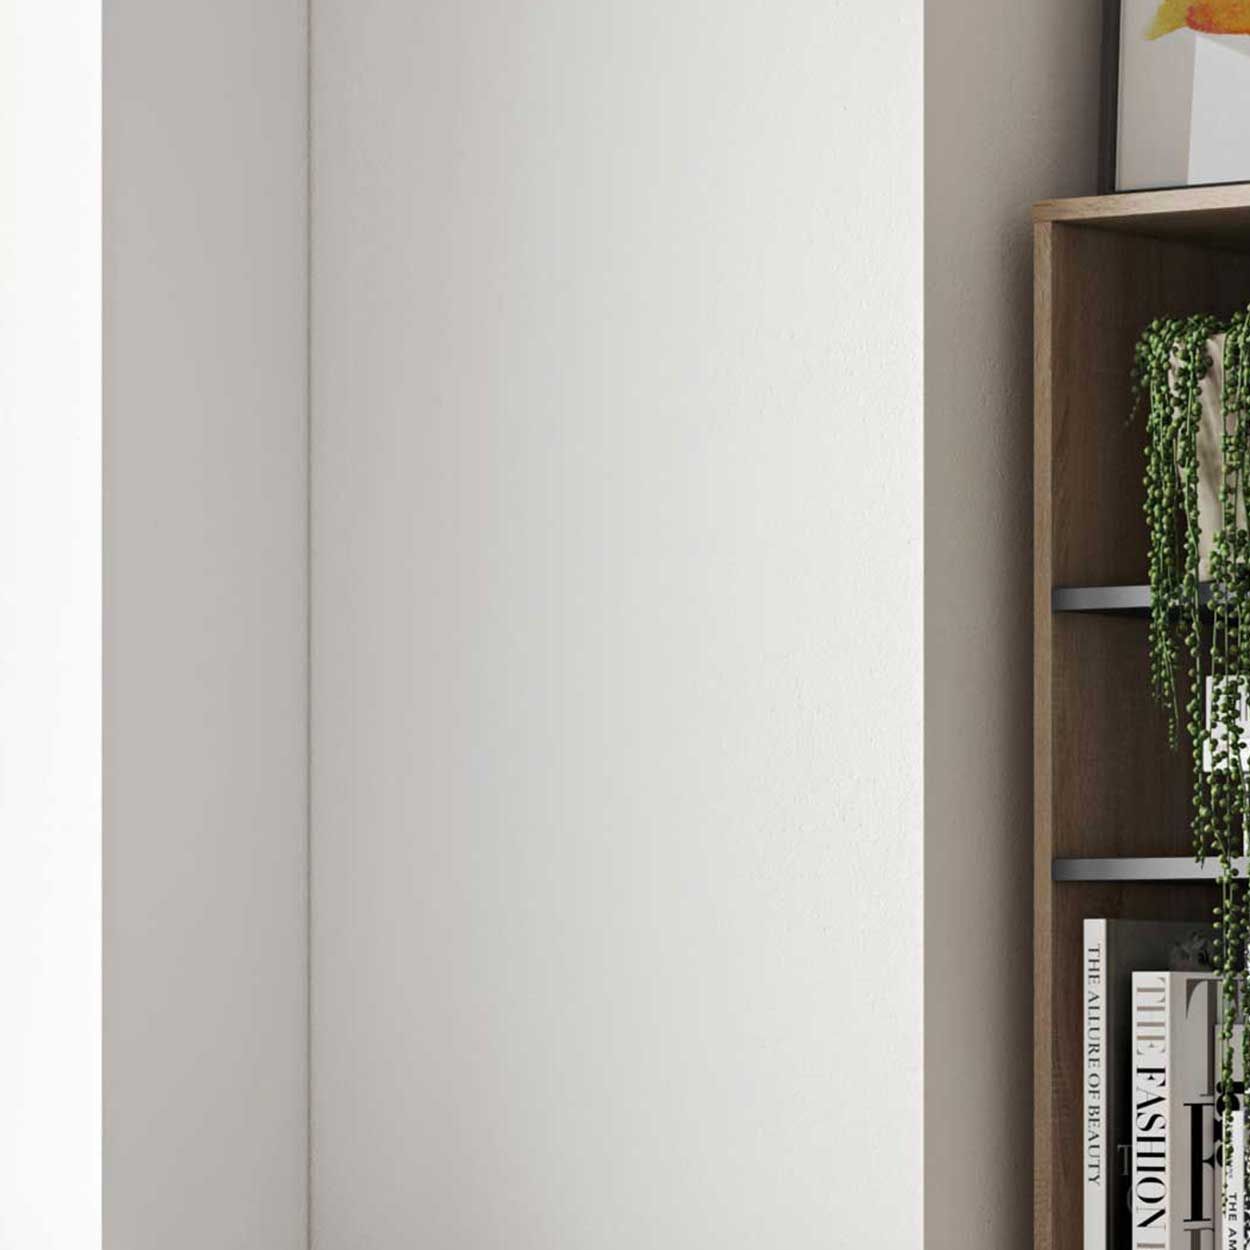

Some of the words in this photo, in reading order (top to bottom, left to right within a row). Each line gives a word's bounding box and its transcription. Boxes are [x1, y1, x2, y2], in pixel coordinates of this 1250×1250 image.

[1088, 944, 1101, 985] THE
[1088, 990, 1101, 1067] ALLURE
[1136, 976, 1166, 1056] THE
[1088, 1073, 1101, 1101] OF
[1088, 1105, 1101, 1185] BEAUTY
[1136, 1067, 1166, 1232] FASHION
[1228, 1193, 1238, 1221] THE
